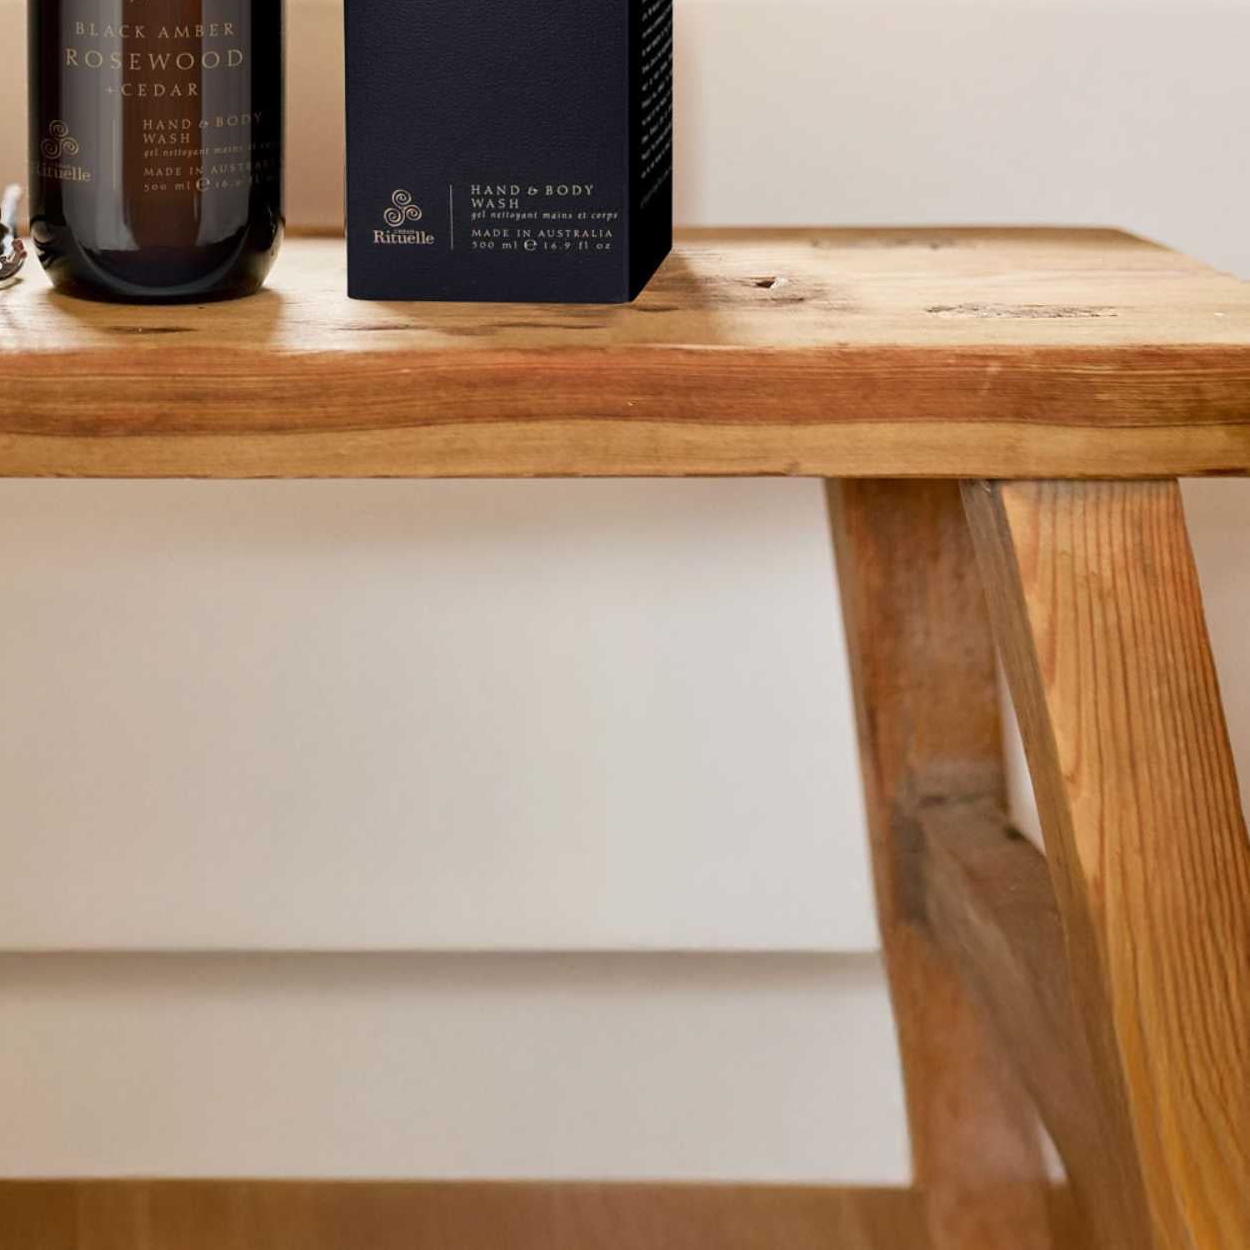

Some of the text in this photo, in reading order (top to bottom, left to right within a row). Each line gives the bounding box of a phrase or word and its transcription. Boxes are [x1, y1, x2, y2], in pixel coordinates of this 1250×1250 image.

[75, 22, 236, 39] BLACK AMBER
[65, 49, 244, 71] ROSEWOOD
[143, 118, 191, 130] HAND
[215, 111, 262, 127] BODY
[143, 132, 190, 144] WASH
[143, 165, 182, 177] MADE
[189, 165, 205, 176] IN
[470, 184, 595, 196] HAND & BODY
[470, 197, 519, 209] WASH
[470, 209, 486, 221] gel
[372, 229, 435, 245] Rituelle
[471, 228, 614, 239] MADE IN AUSTRALIA
[471, 240, 495, 250] 500
[501, 240, 518, 250] ml
